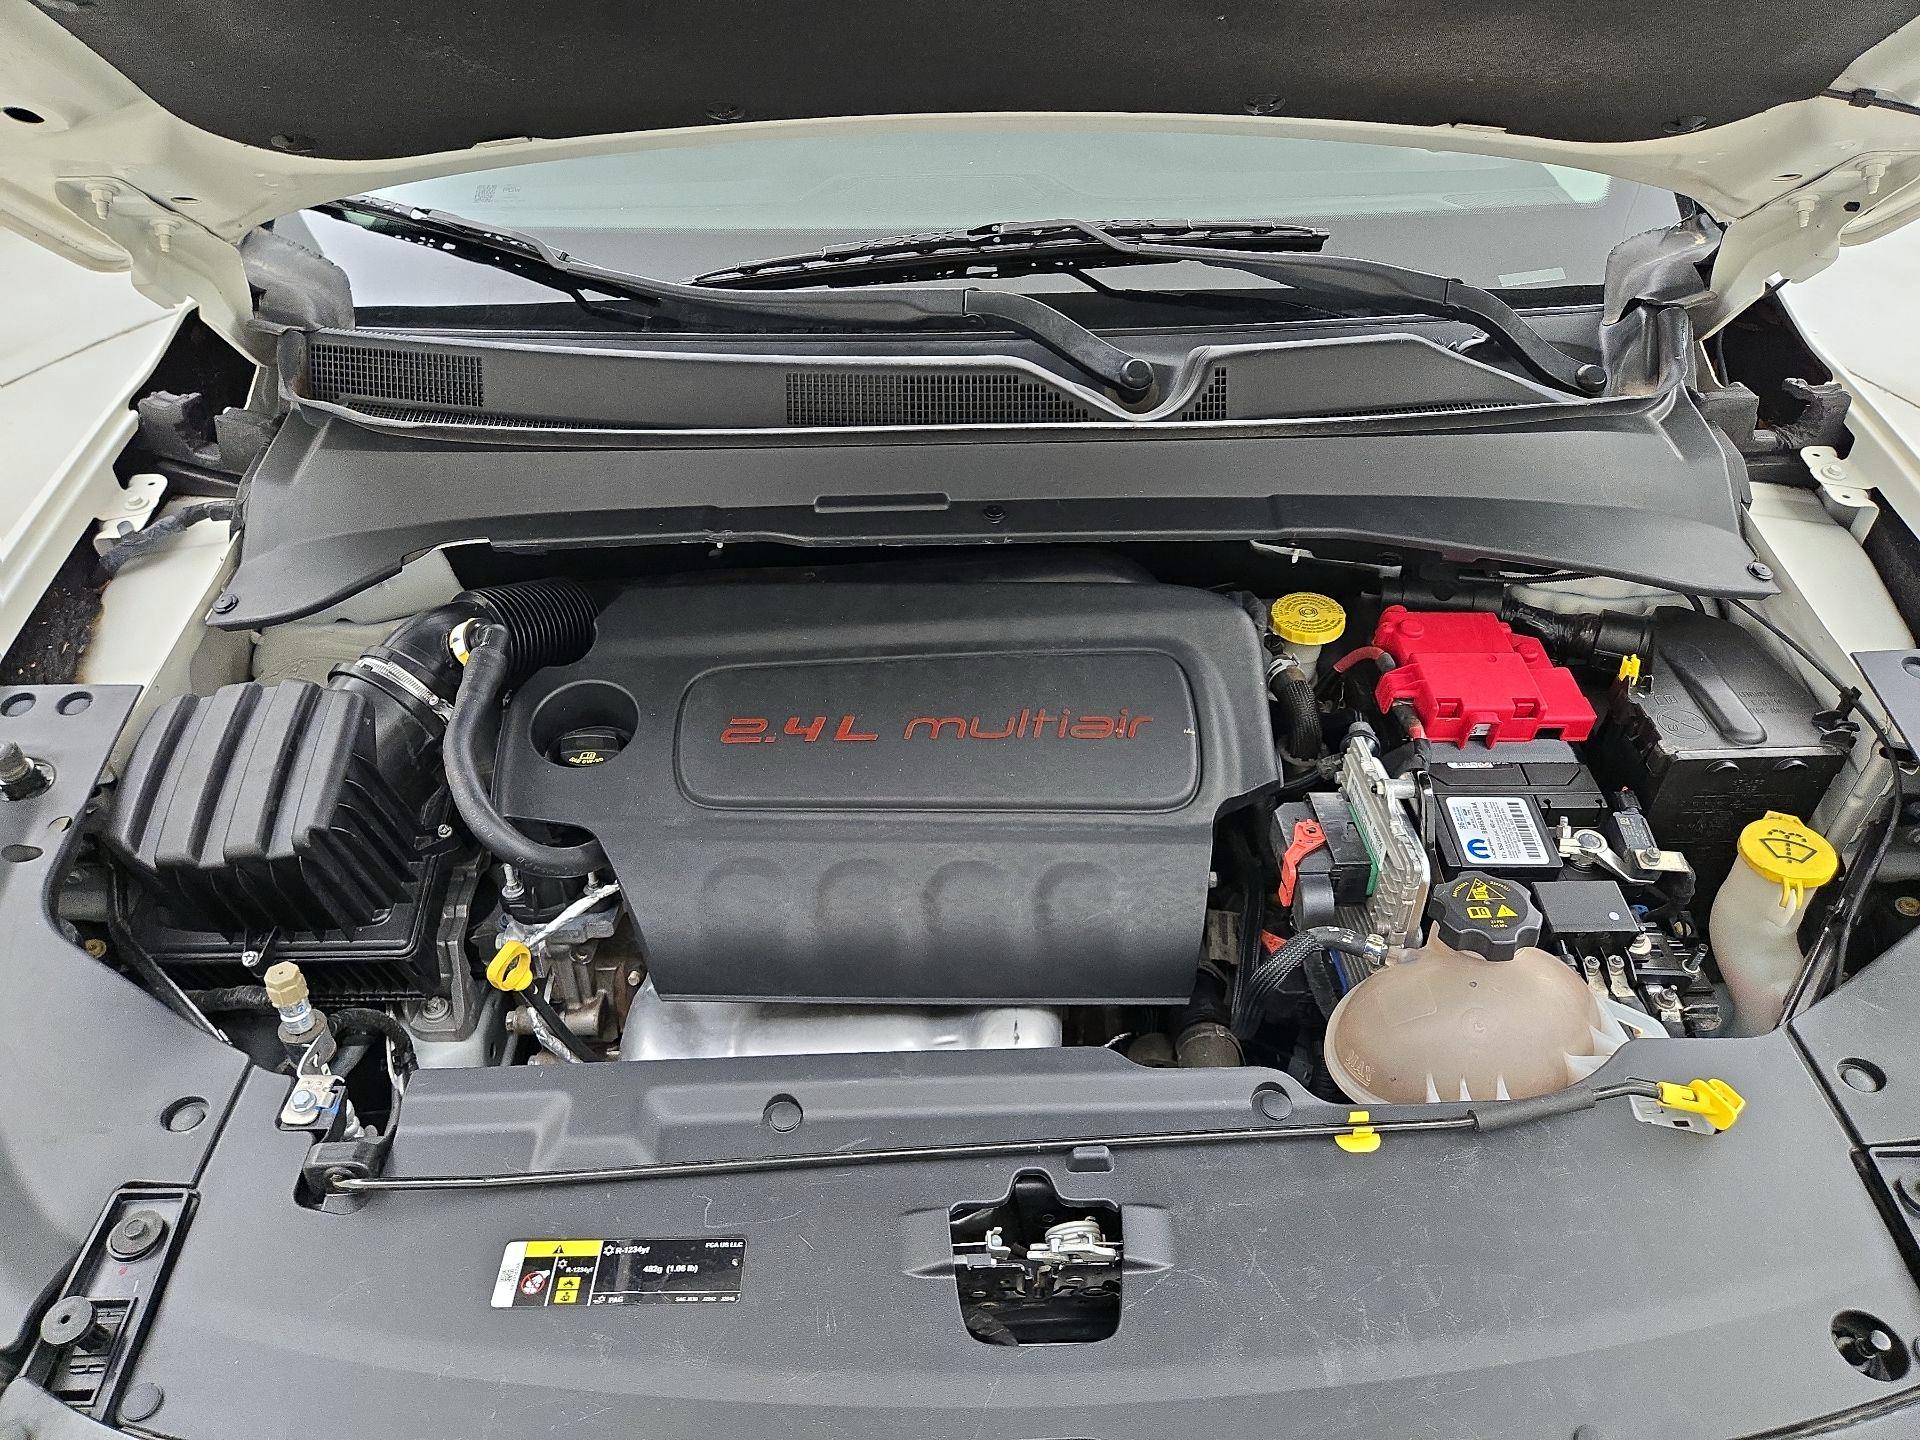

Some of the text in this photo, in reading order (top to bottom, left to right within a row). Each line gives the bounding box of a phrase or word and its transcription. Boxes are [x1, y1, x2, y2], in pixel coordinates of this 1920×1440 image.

[904, 707, 1154, 740] multiair
[614, 1246, 651, 1255] R-1234yf
[565, 1266, 594, 1274] R-1234yf
